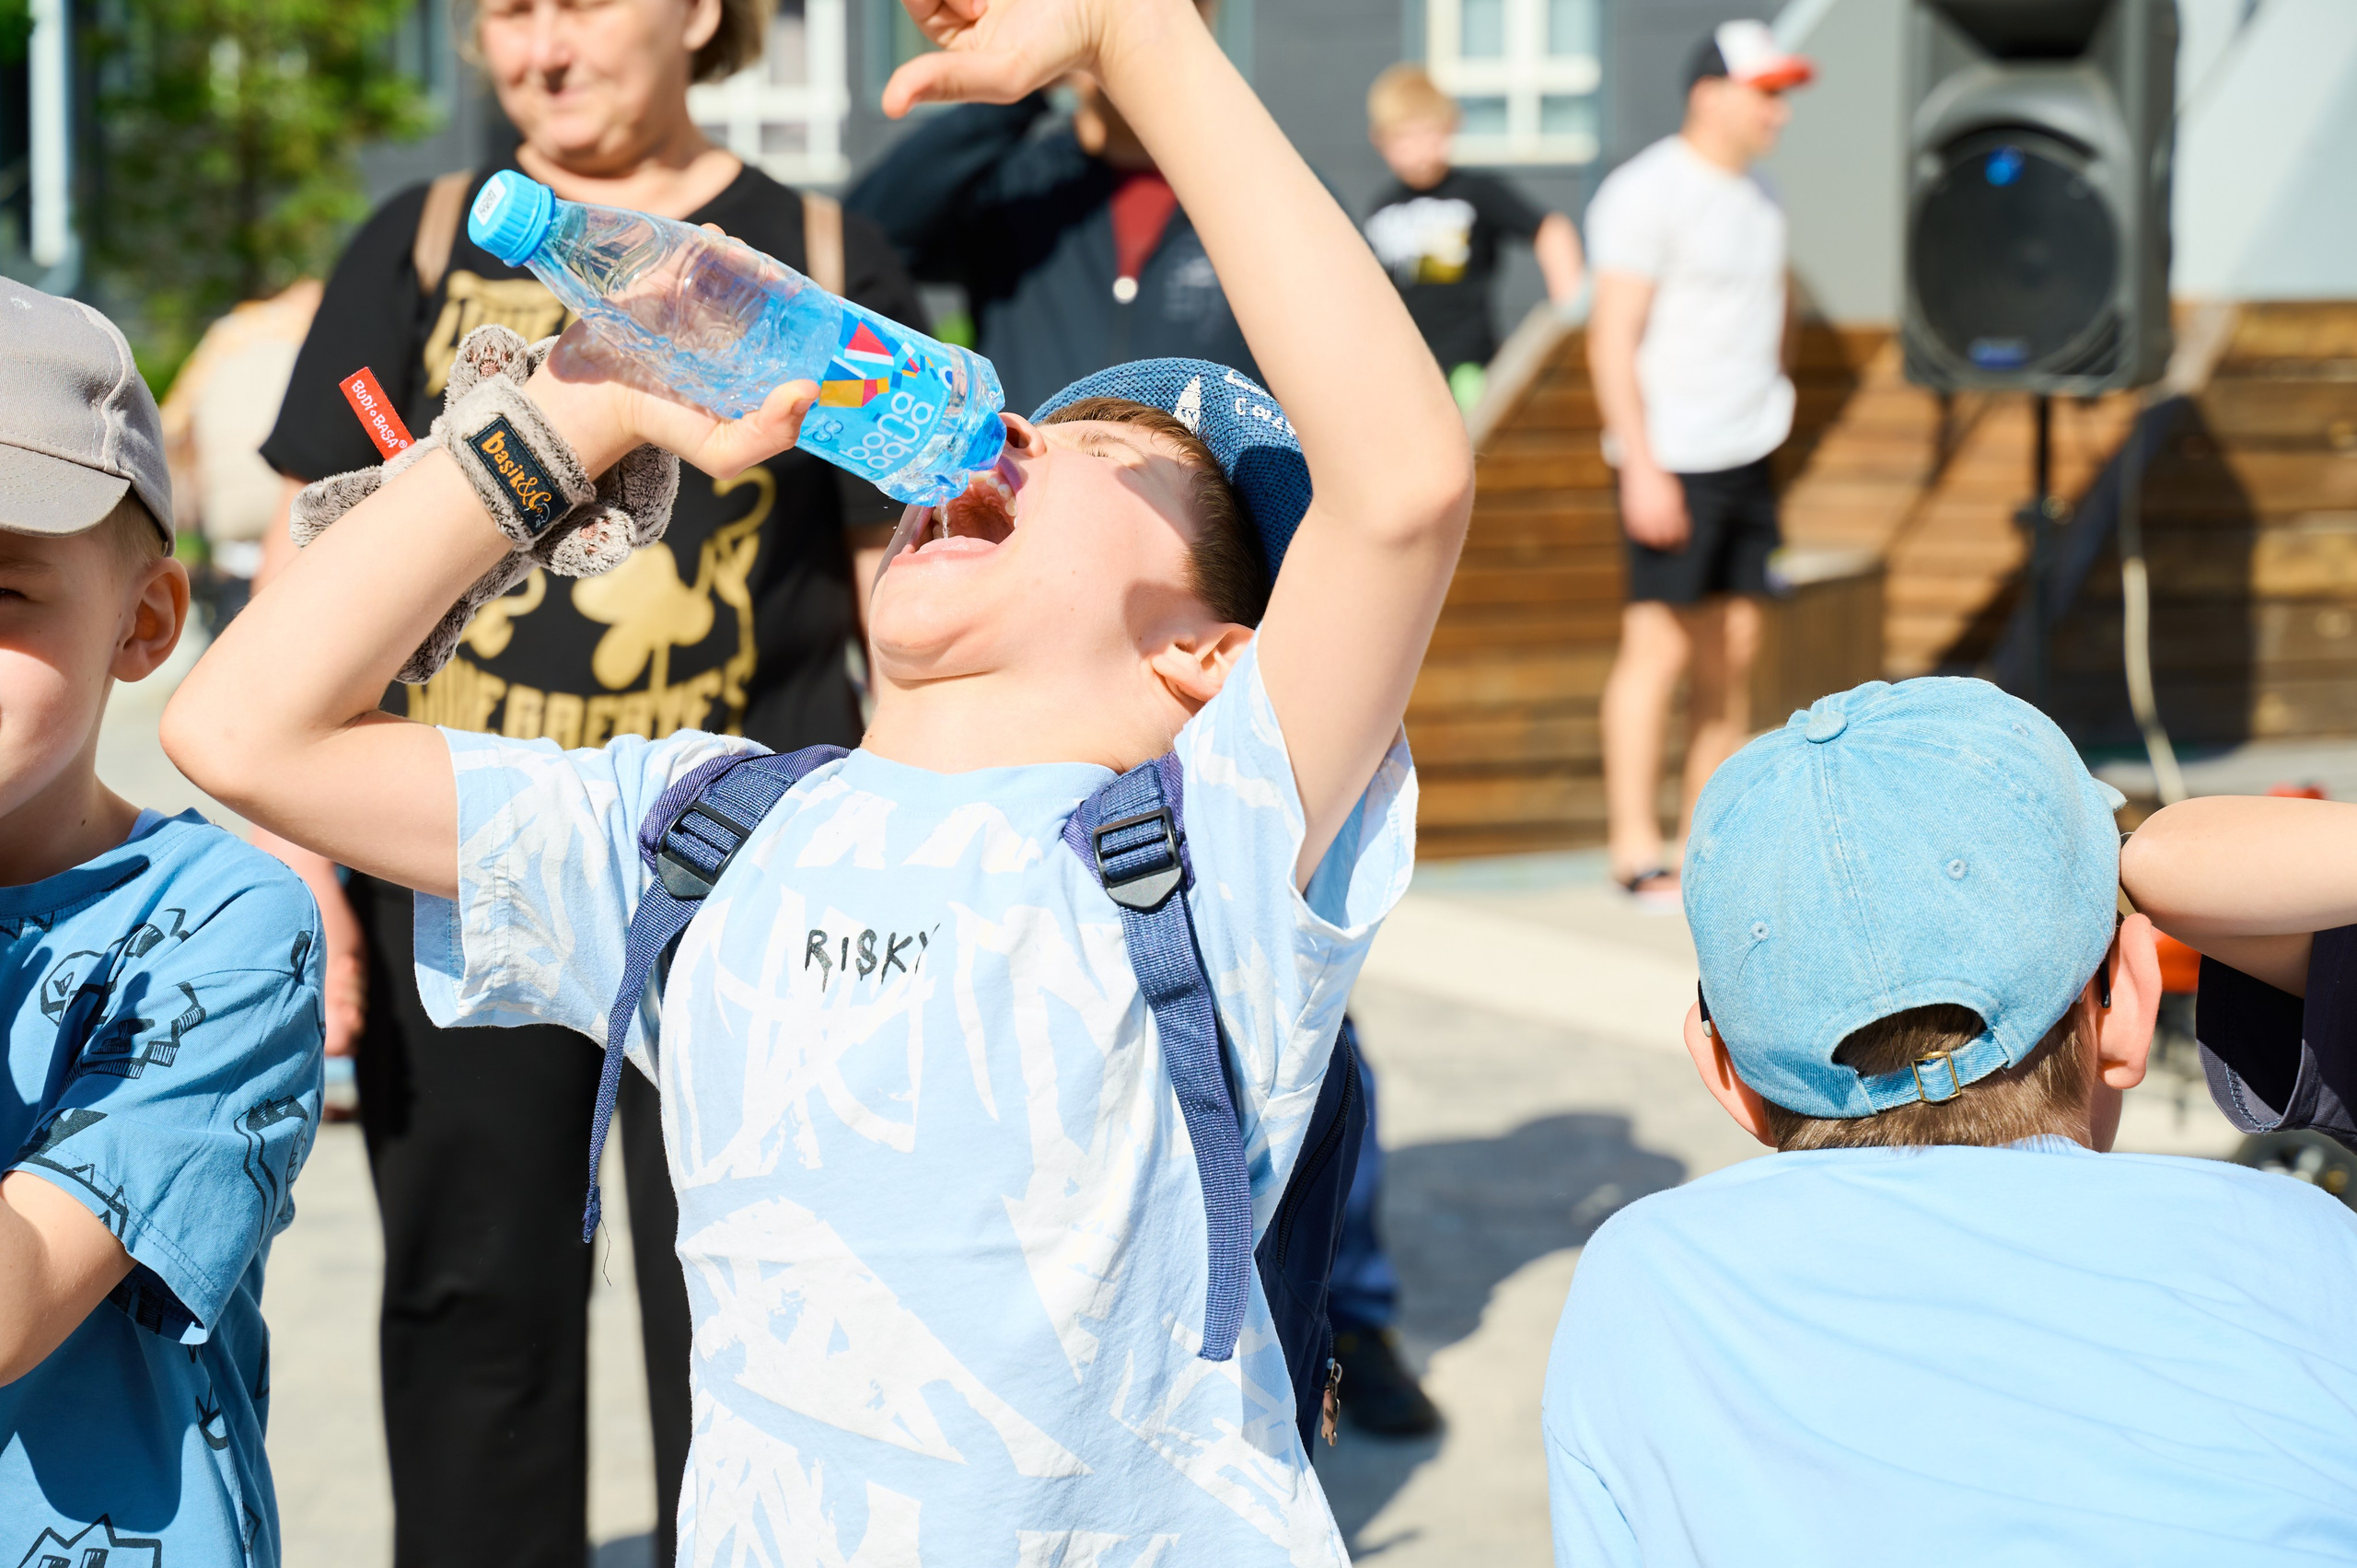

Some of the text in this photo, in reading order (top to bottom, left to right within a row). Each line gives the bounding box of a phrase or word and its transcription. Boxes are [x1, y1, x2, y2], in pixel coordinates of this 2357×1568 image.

[839, 390, 916, 460] bona
[866, 401, 935, 470] aqua
[805, 922, 941, 993] RISKY
